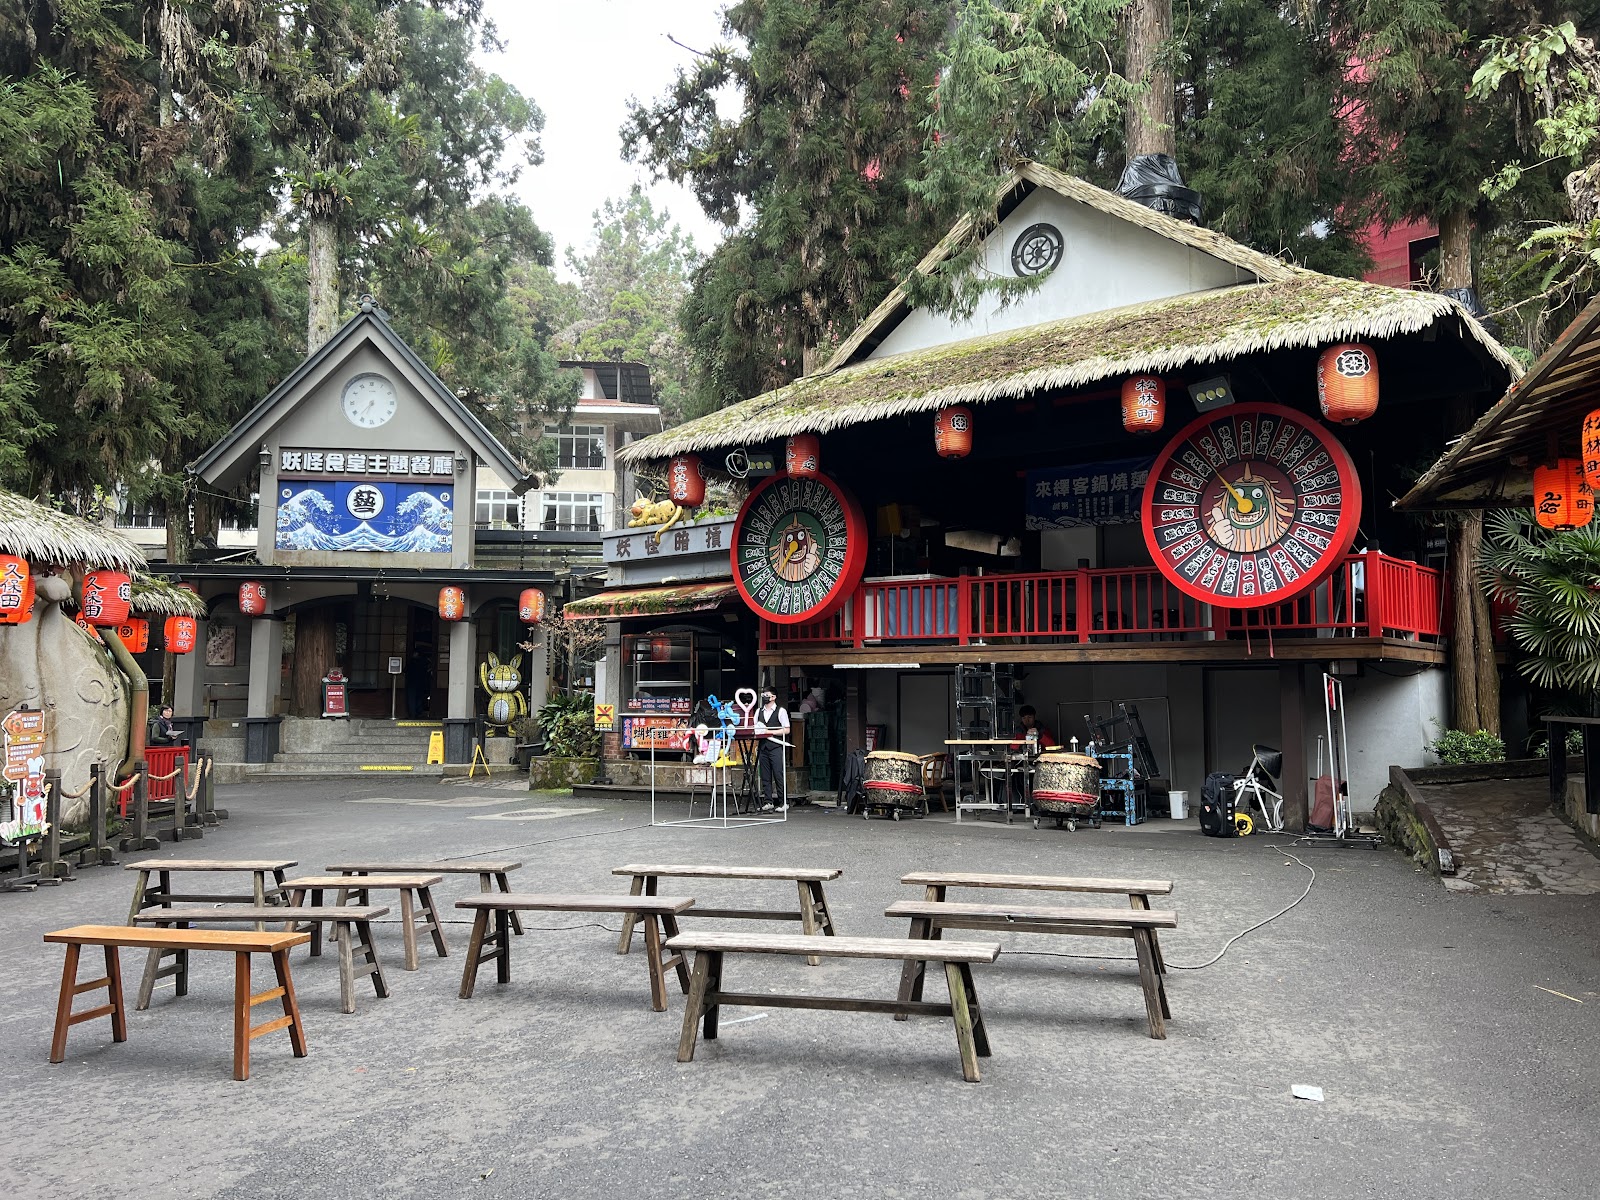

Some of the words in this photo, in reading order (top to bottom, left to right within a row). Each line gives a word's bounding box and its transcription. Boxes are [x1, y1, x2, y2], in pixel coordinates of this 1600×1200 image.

[1136, 379, 1159, 423] 松林町
[282, 452, 452, 474] 妖怪食堂主題餐廳
[1036, 470, 1149, 498] 來繹客鍋燒麵
[0, 564, 25, 608] 久保田
[84, 576, 104, 618] 久保田
[177, 621, 192, 649] 松林町
